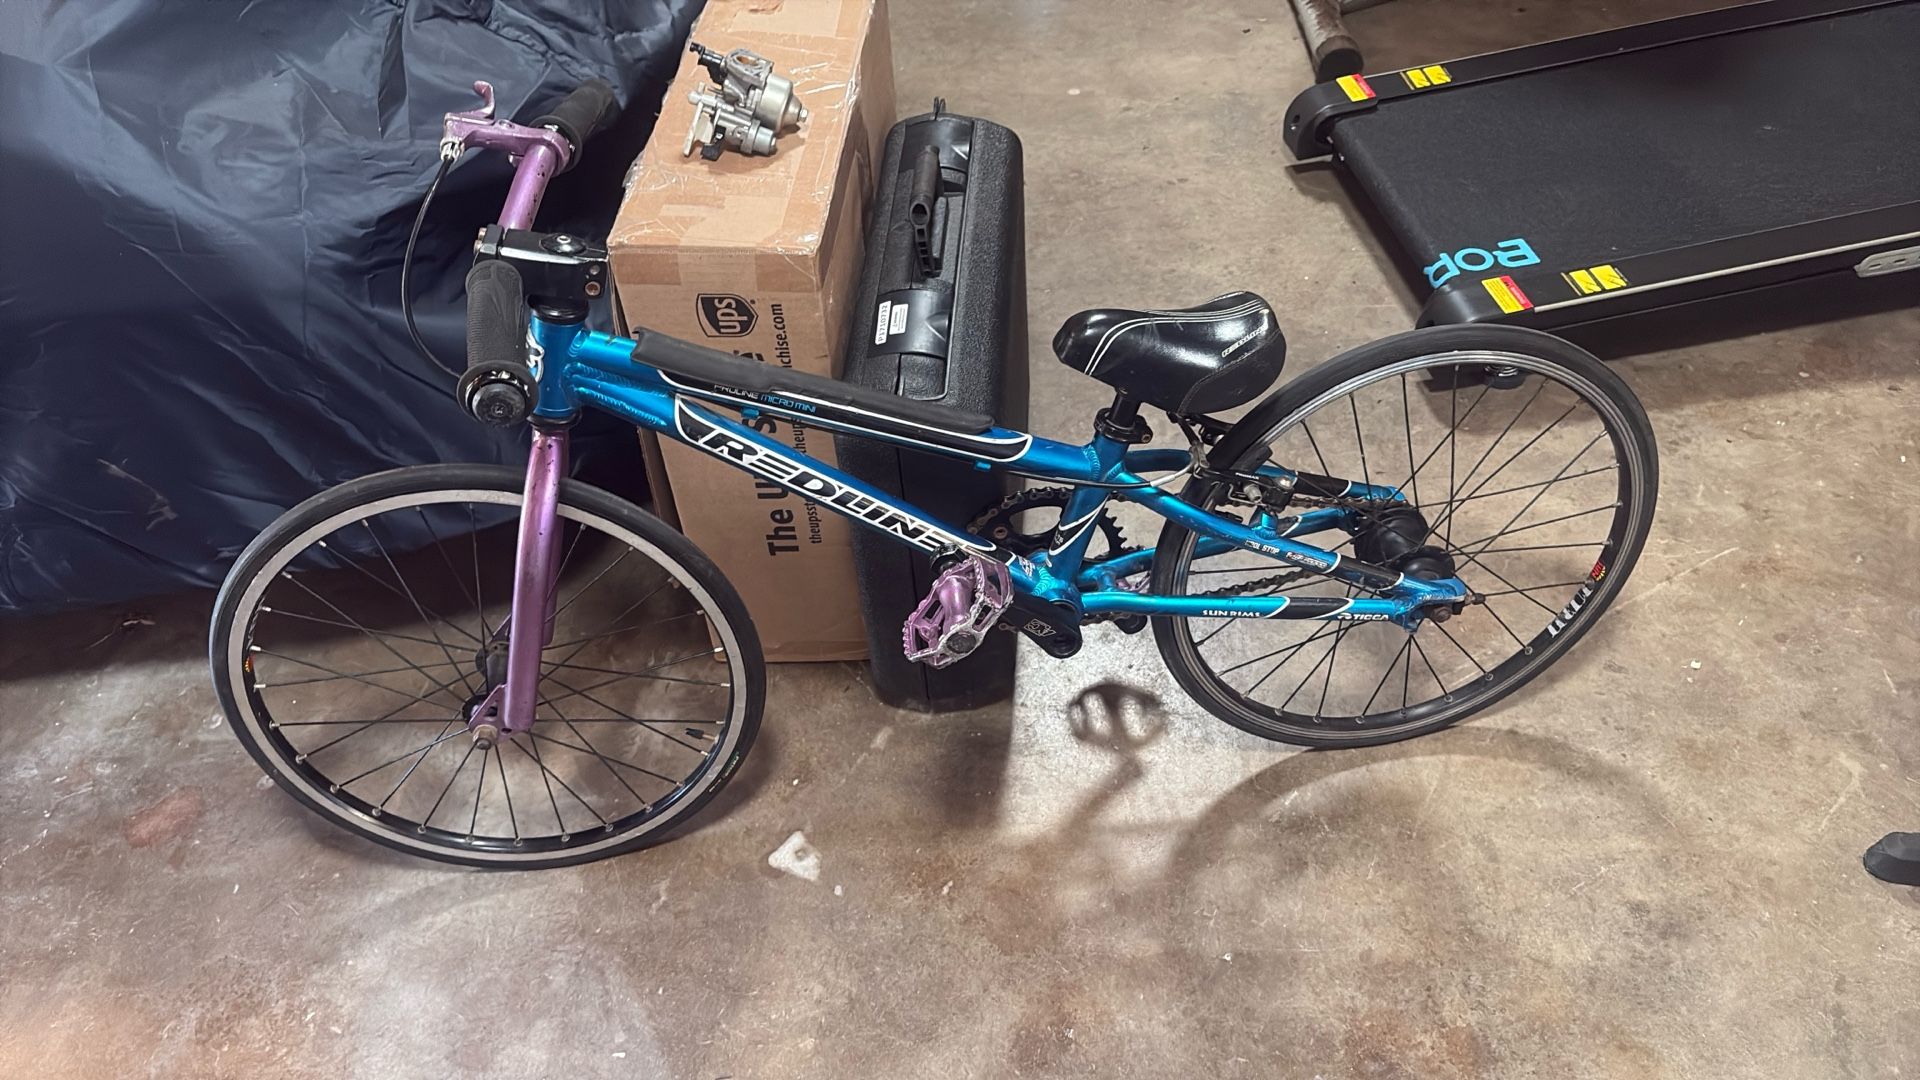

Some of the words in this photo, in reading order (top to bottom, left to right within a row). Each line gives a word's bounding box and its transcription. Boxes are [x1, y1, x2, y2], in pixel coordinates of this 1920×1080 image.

[713, 298, 749, 334] ups
[760, 394, 794, 407] MICRO
[794, 402, 817, 413] MINI
[765, 508, 800, 557] The
